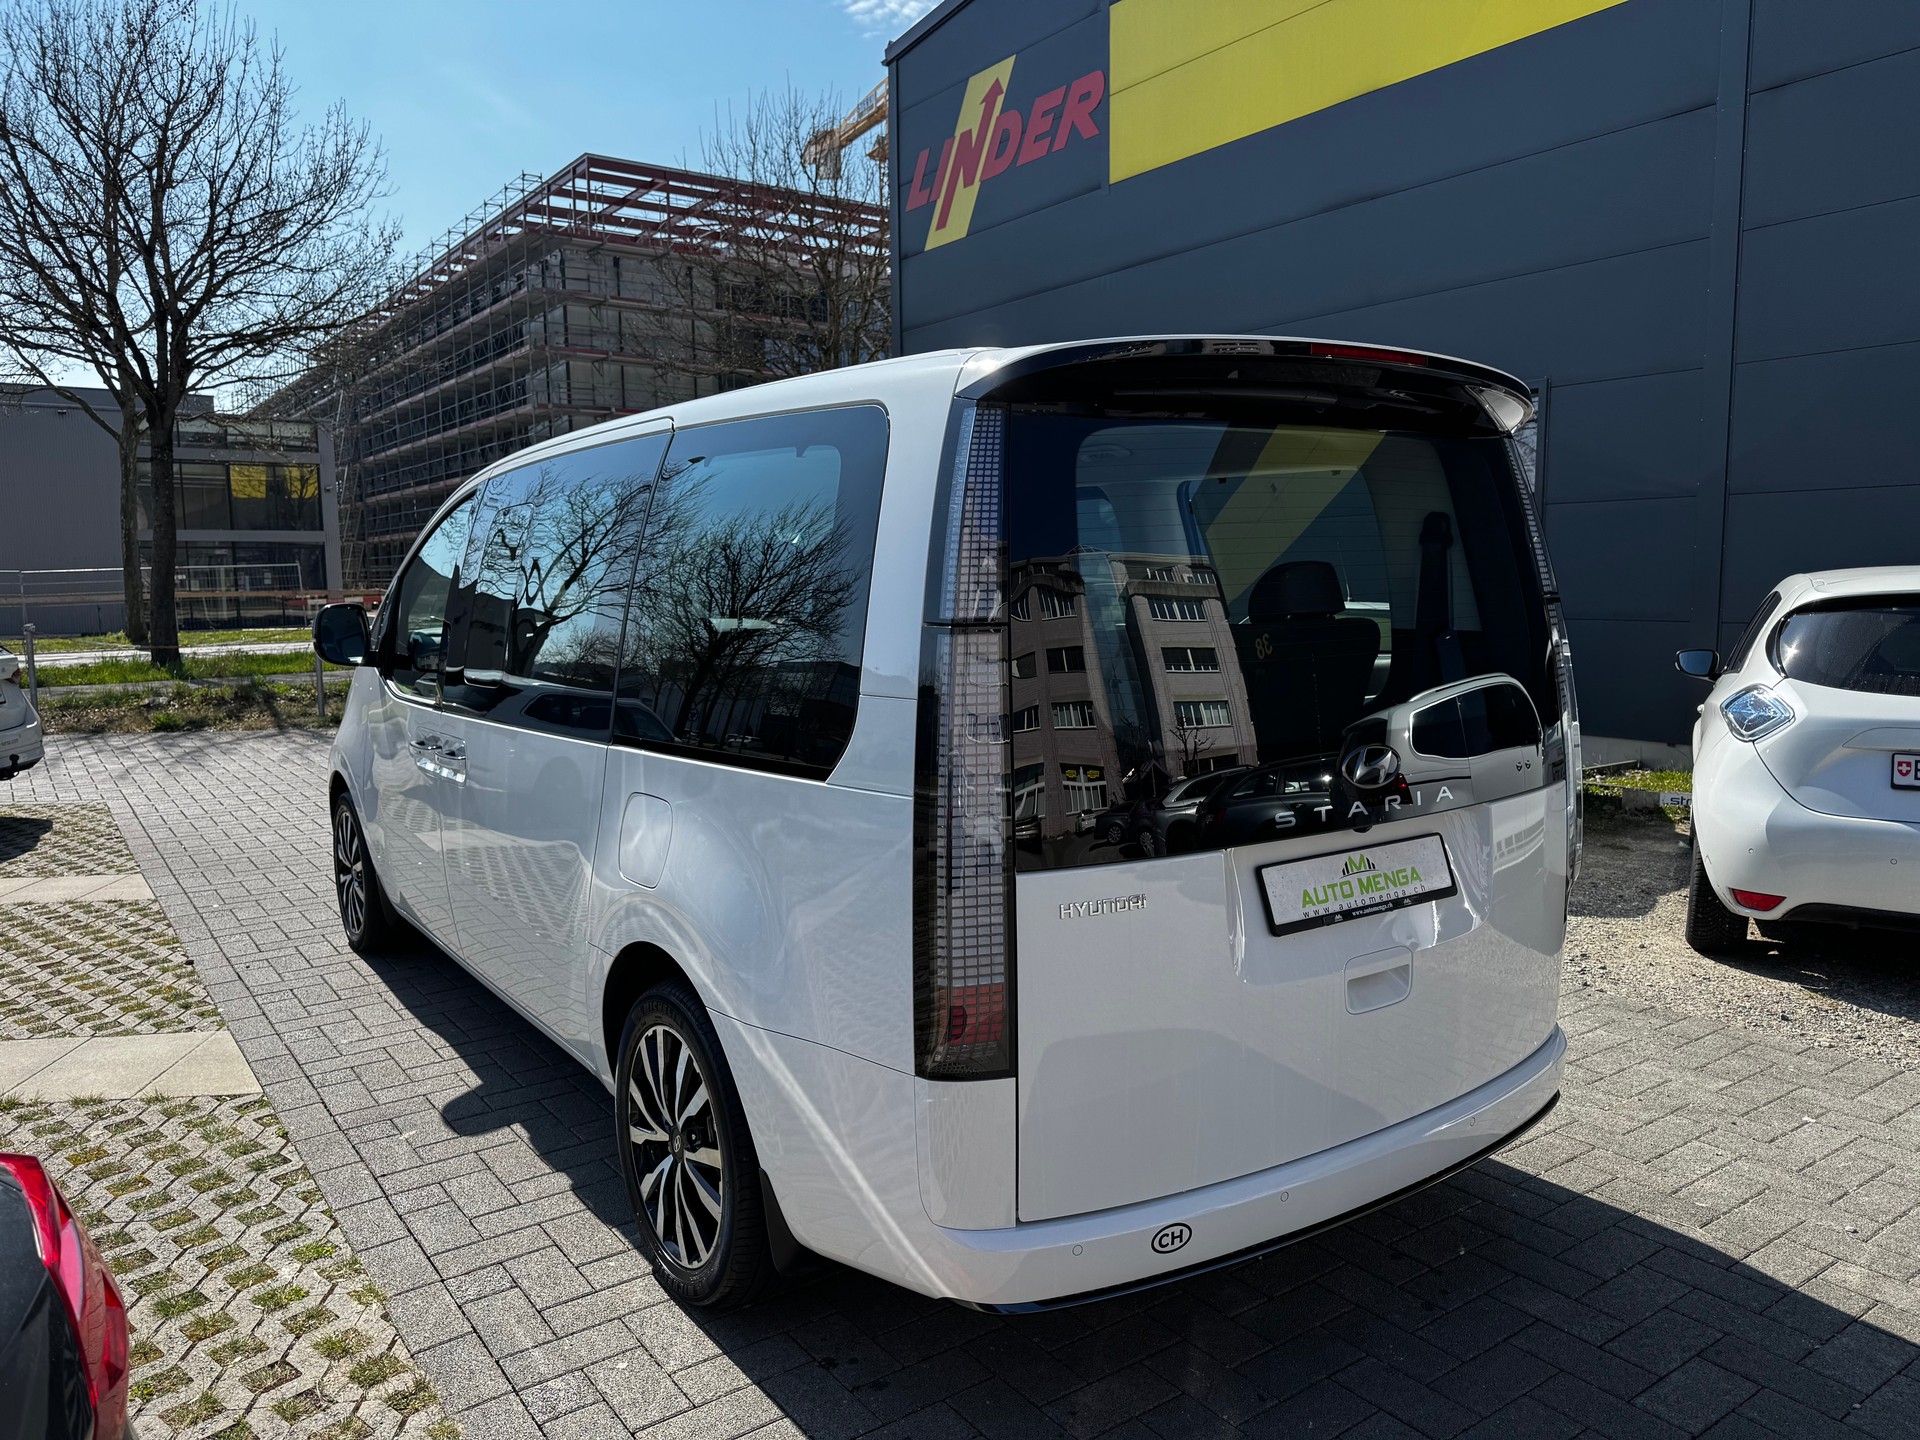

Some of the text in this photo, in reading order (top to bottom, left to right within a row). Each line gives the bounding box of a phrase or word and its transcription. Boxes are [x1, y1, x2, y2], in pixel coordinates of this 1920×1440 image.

[905, 70, 1105, 231] LINDER
[1275, 786, 1453, 829] STARIA
[1059, 893, 1147, 920] HYUNDAI
[1302, 866, 1422, 909] AUTO MENGA
[1158, 1228, 1184, 1249] CH
